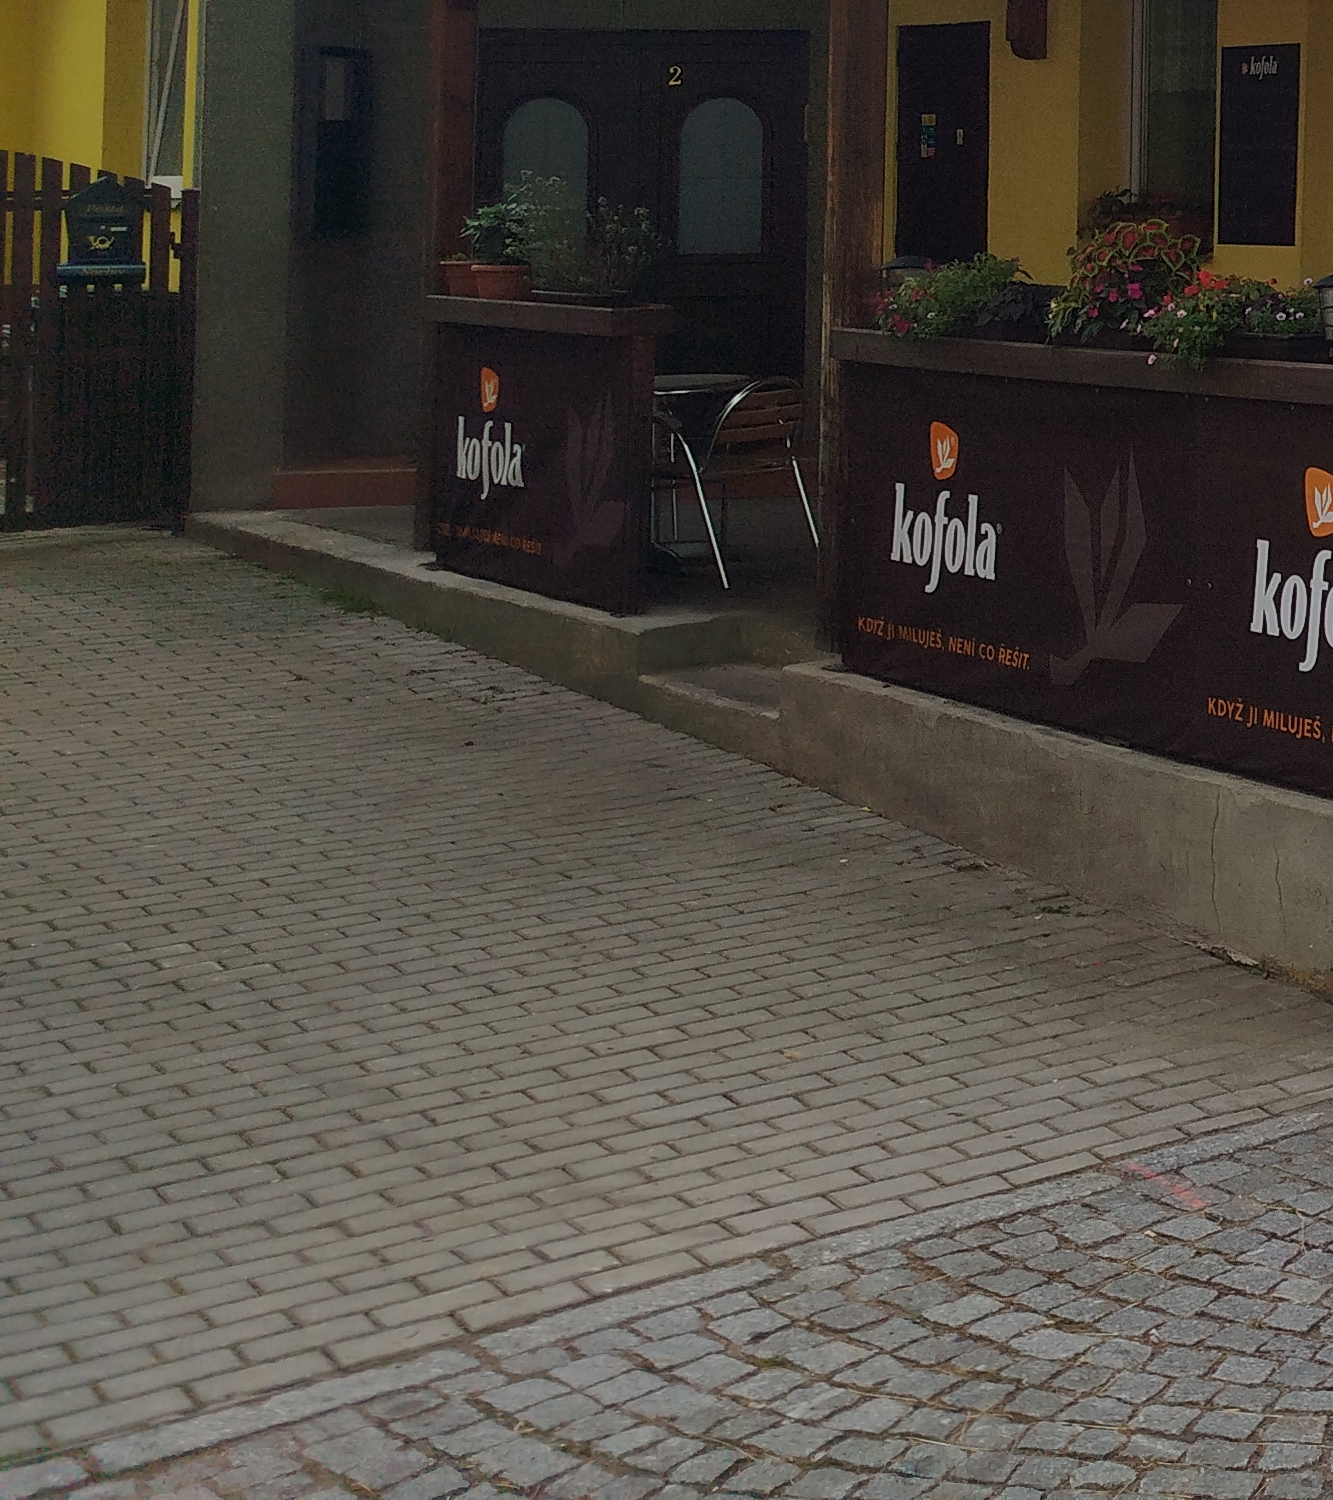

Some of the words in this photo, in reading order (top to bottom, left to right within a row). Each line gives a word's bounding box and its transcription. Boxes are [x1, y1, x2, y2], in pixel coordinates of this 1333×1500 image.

[668, 65, 682, 86] 2
[1249, 55, 1278, 81] kofola
[457, 415, 524, 500] kofola
[891, 482, 995, 593] kofola
[857, 615, 885, 637] KDYŽ
[886, 622, 896, 641] JI
[898, 624, 945, 651] MILUJEŠ,
[948, 636, 976, 658] NENÍ
[978, 643, 995, 661] CO
[998, 642, 1030, 671] ŘEŠIT.
[1207, 697, 1244, 722] KDYŽ
[1246, 706, 1258, 728] JI
[1262, 708, 1325, 743] MILUJEŠ,
